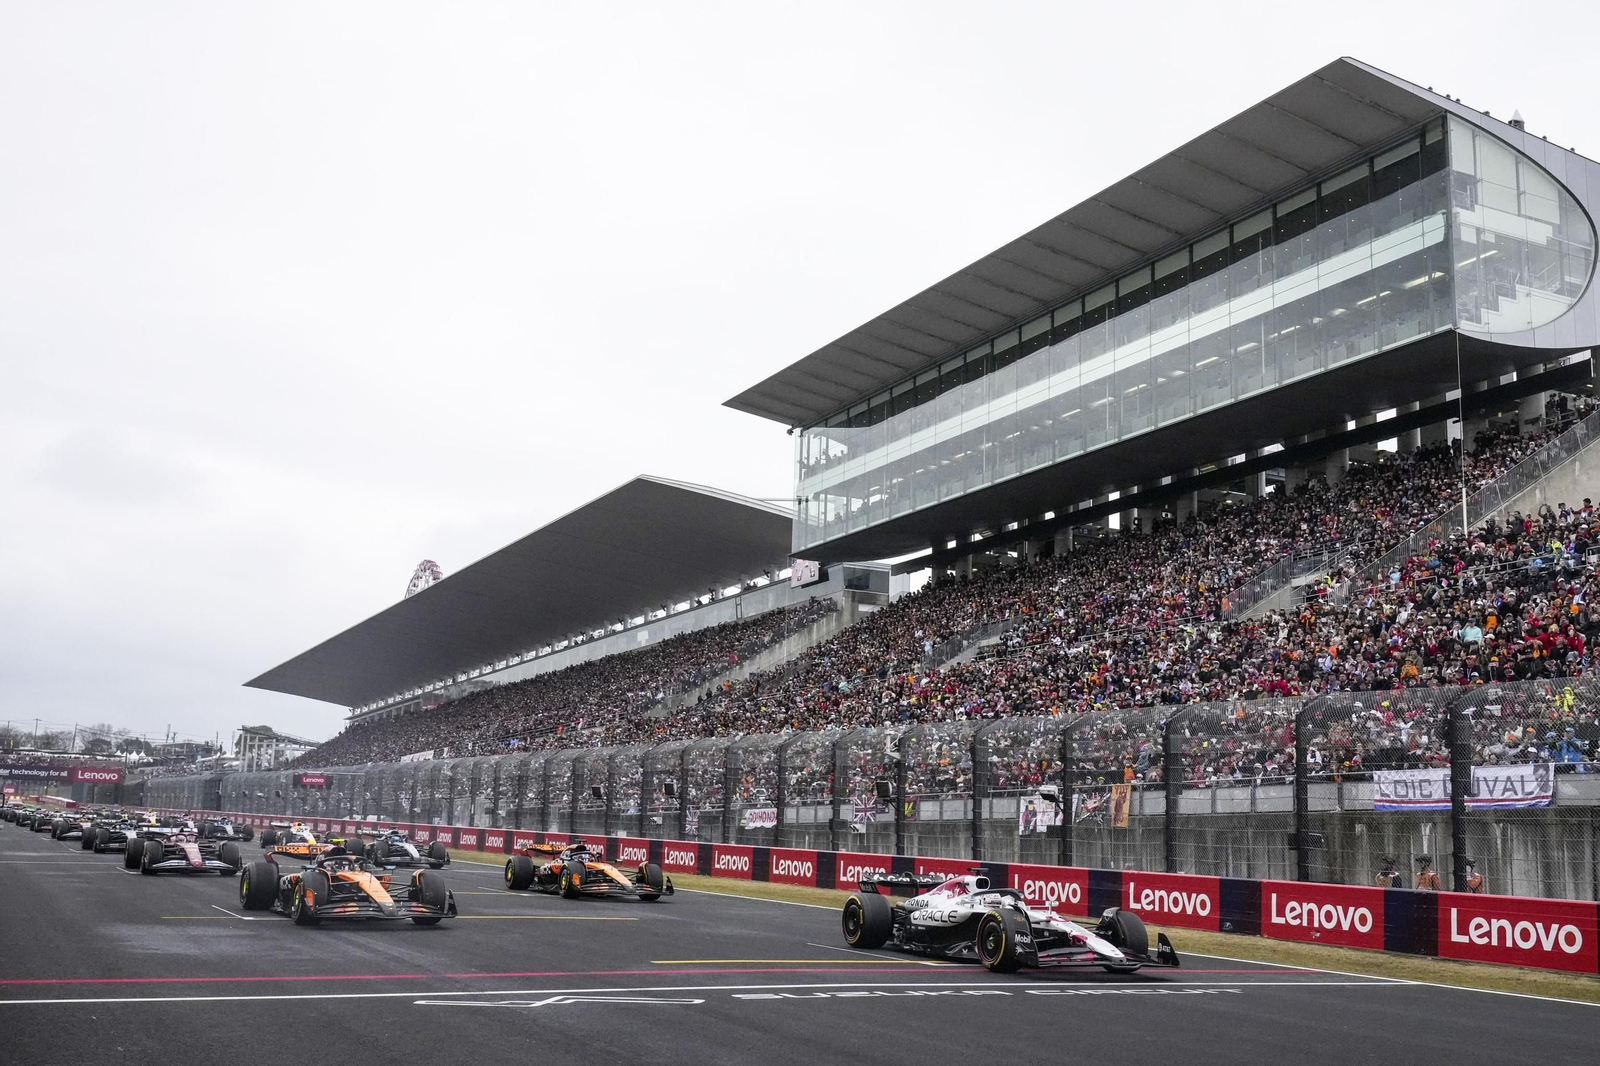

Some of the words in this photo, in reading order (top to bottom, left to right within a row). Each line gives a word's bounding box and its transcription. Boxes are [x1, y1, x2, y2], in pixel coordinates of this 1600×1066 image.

[78, 770, 118, 780] Lenovo
[415, 829, 429, 841] Lenovo
[437, 829, 452, 843] Lenovo
[460, 832, 476, 845] Lenovo
[485, 834, 503, 847] Lenovo
[619, 843, 647, 861] Lenovo
[664, 847, 695, 867] Lenovo
[715, 850, 749, 871] Lenovo
[773, 854, 813, 878] Lenovo
[1014, 874, 1081, 904] Lenovo
[906, 899, 928, 908] HONDA
[1129, 882, 1211, 917] Lenovo
[912, 910, 960, 924] ORACLE
[1271, 893, 1373, 933] Lenovo
[1450, 907, 1583, 954] Lenovo
[1015, 934, 1031, 944] Mobil
